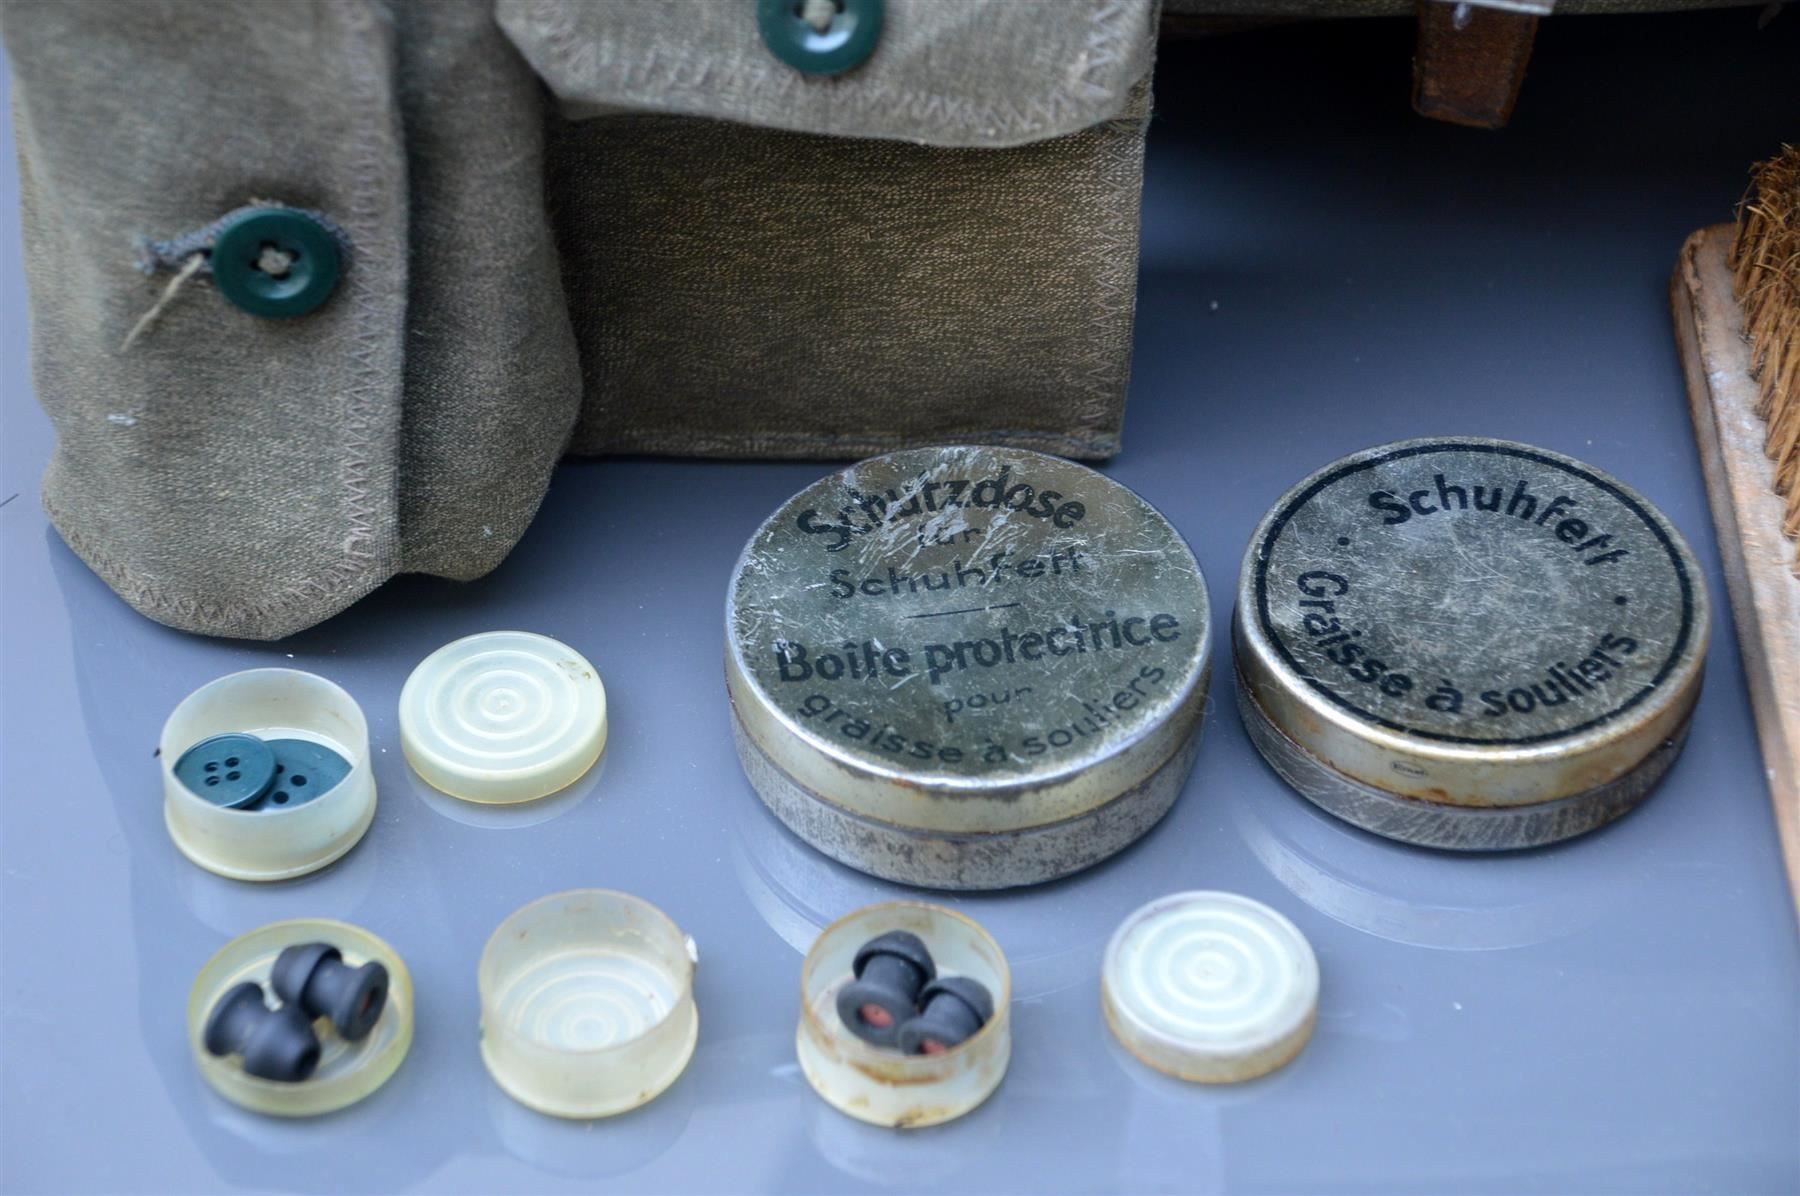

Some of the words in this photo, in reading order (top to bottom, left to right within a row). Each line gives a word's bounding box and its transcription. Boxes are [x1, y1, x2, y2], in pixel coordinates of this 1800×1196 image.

[1367, 473, 1629, 567] Schuhfett
[828, 546, 1083, 600] Schuhfett
[776, 637, 911, 683] Boîte
[924, 609, 1182, 685] protectrice
[1296, 569, 1414, 699] Graisse
[1424, 679, 1464, 715] à
[1480, 631, 1639, 718] souliers
[798, 693, 965, 765] graisse
[983, 742, 1009, 764] à
[1021, 665, 1166, 756] souliers
[942, 685, 1033, 724] pour
